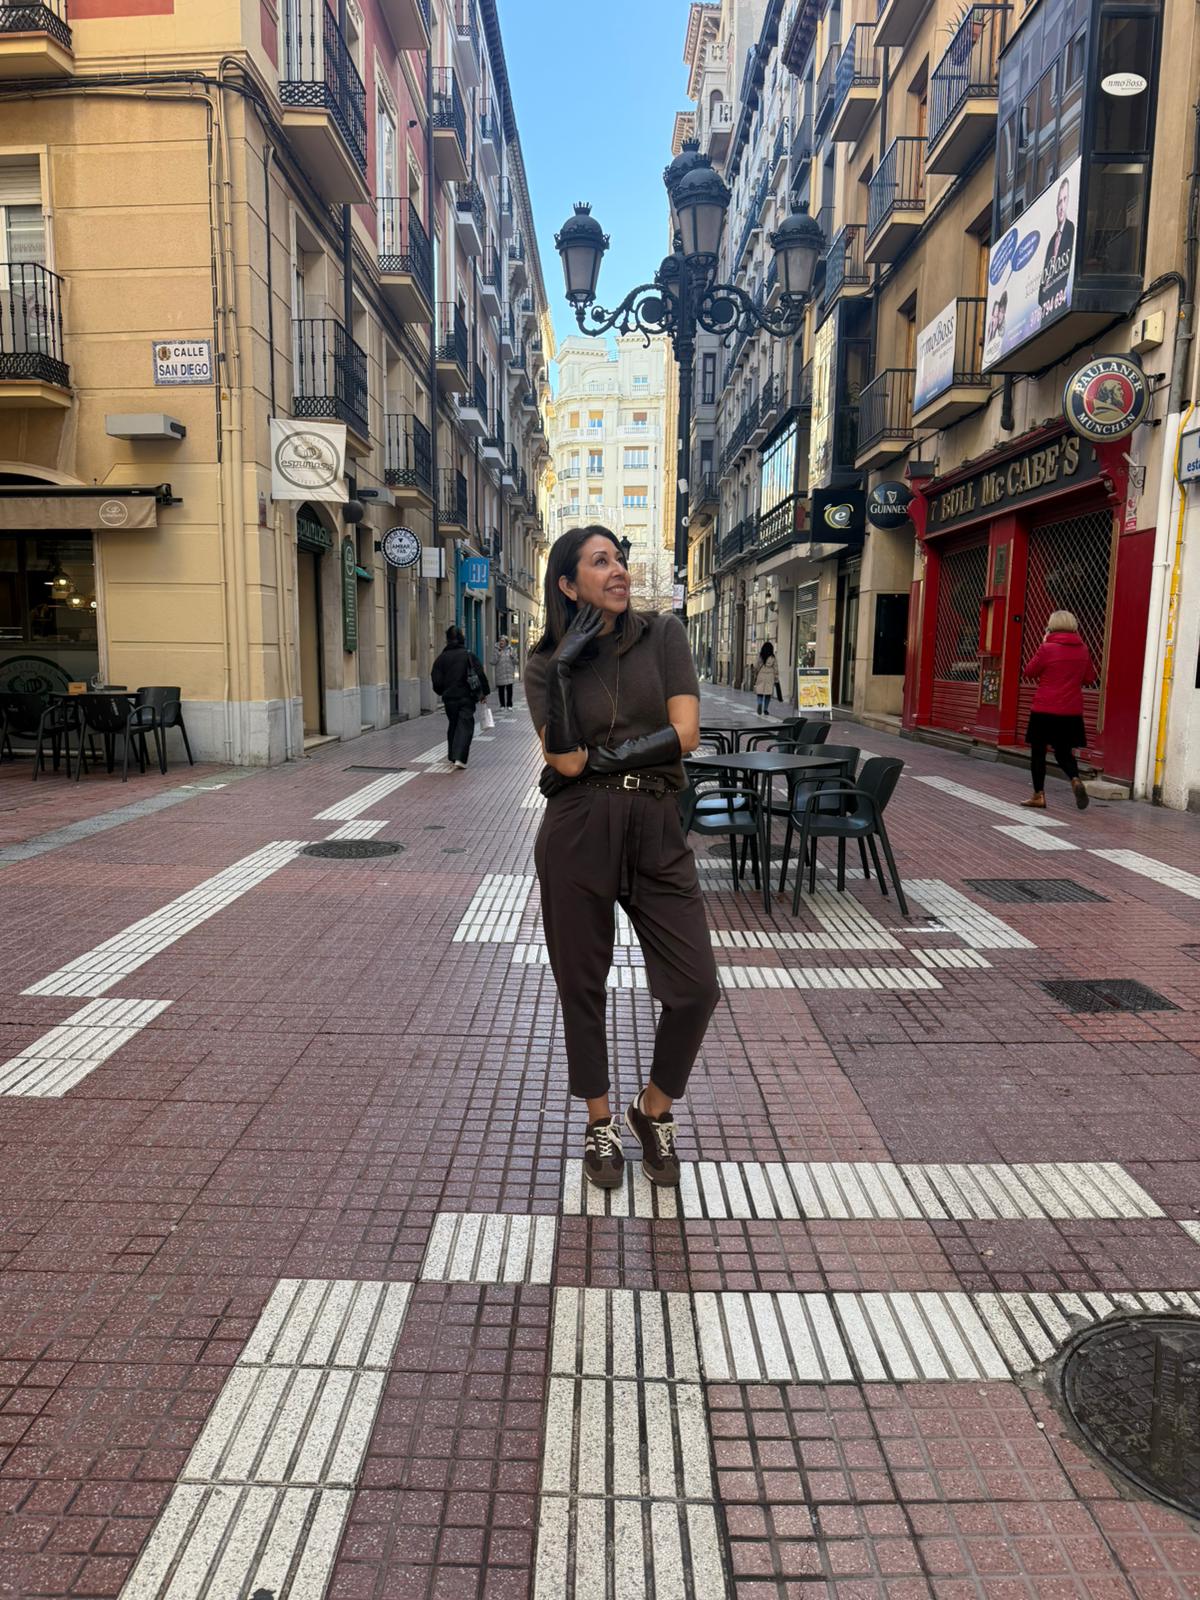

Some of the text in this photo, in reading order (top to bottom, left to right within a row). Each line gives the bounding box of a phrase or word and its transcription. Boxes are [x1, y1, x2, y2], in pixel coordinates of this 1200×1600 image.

[174, 347, 204, 357] CALLE
[159, 363, 209, 376] SAN DIEGO
[1075, 362, 1142, 392] PAULANER
[940, 481, 976, 522] BULL
[387, 530, 416, 544] CERVEZA
